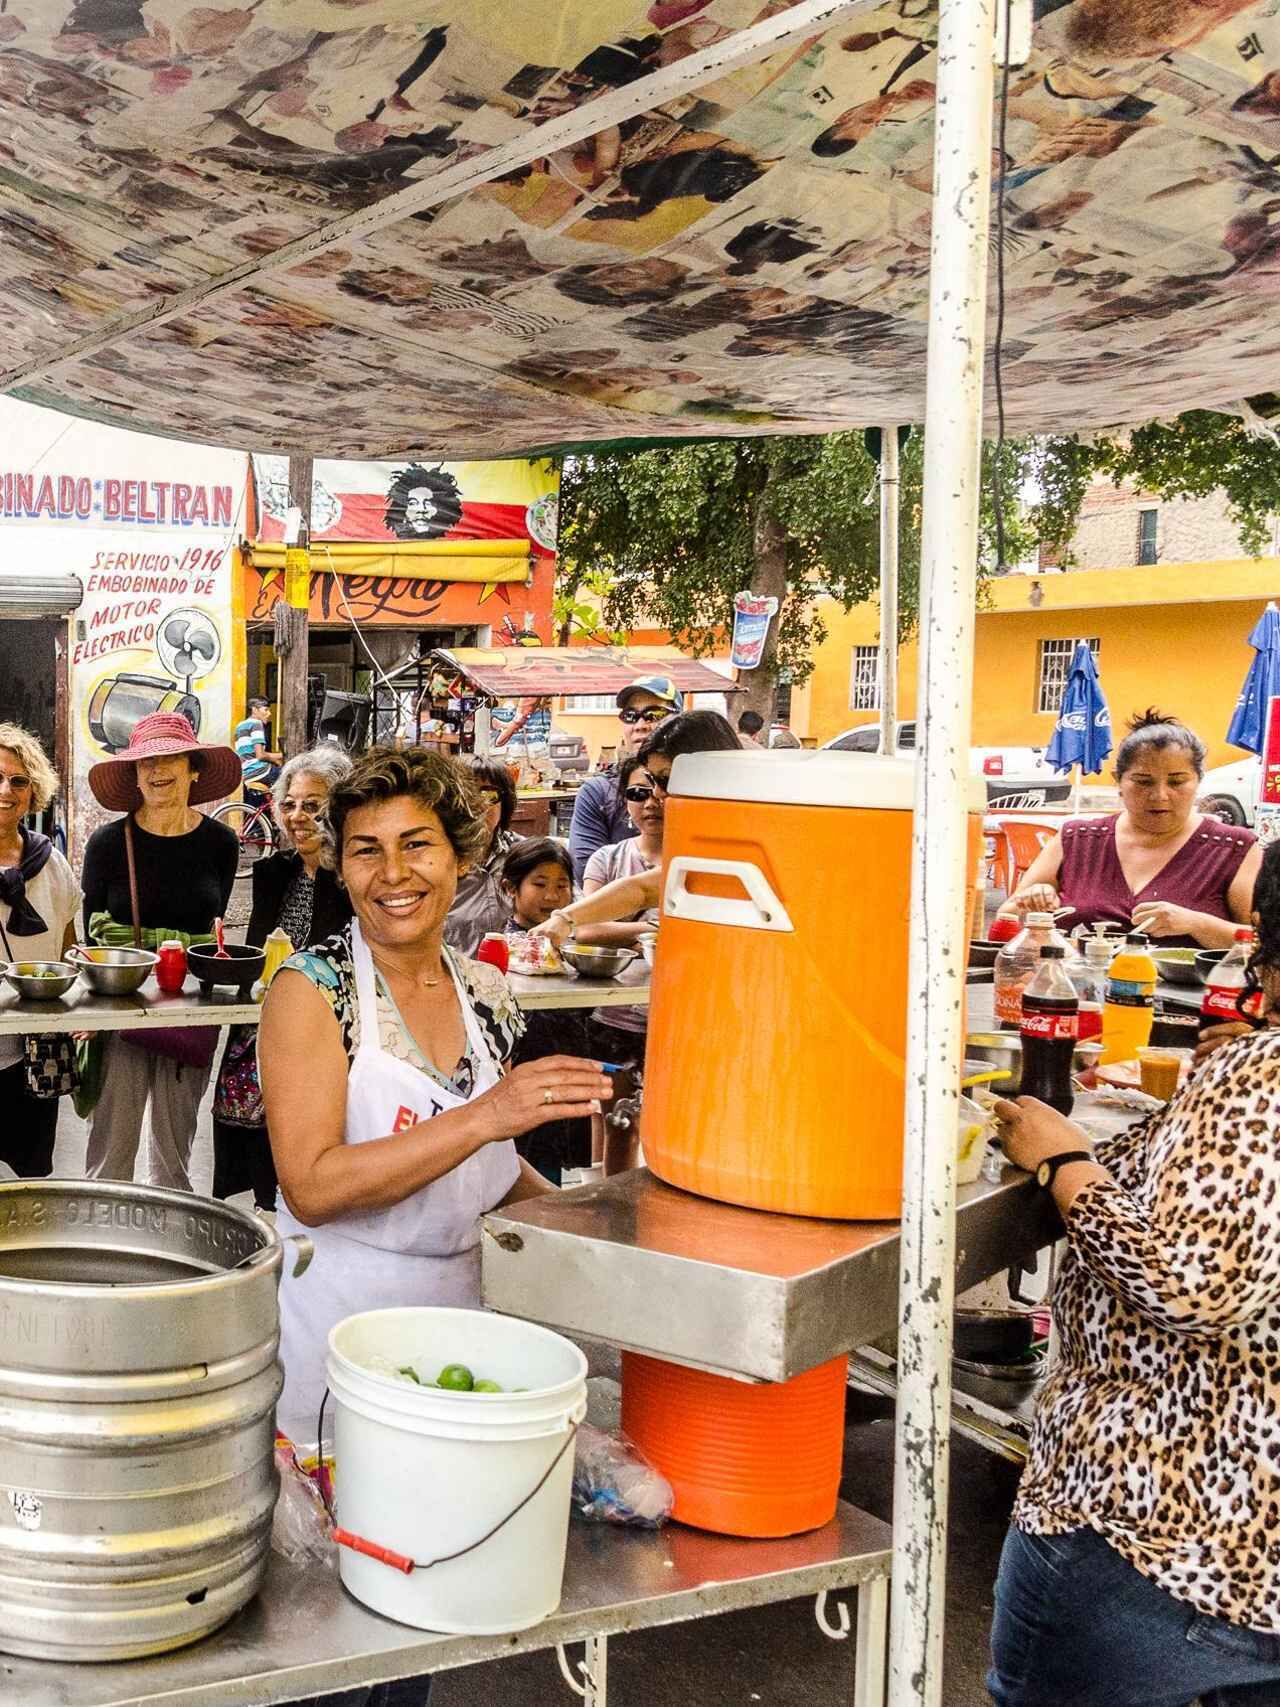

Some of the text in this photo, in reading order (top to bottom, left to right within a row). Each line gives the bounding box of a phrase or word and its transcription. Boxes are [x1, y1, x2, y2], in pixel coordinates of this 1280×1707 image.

[103, 478, 233, 527] BELTRAN
[90, 552, 170, 572] SERVICIO
[87, 574, 216, 595] EMBOBINADO DE
[90, 598, 162, 630] MOTOR
[73, 623, 154, 665] ELECTRICO
